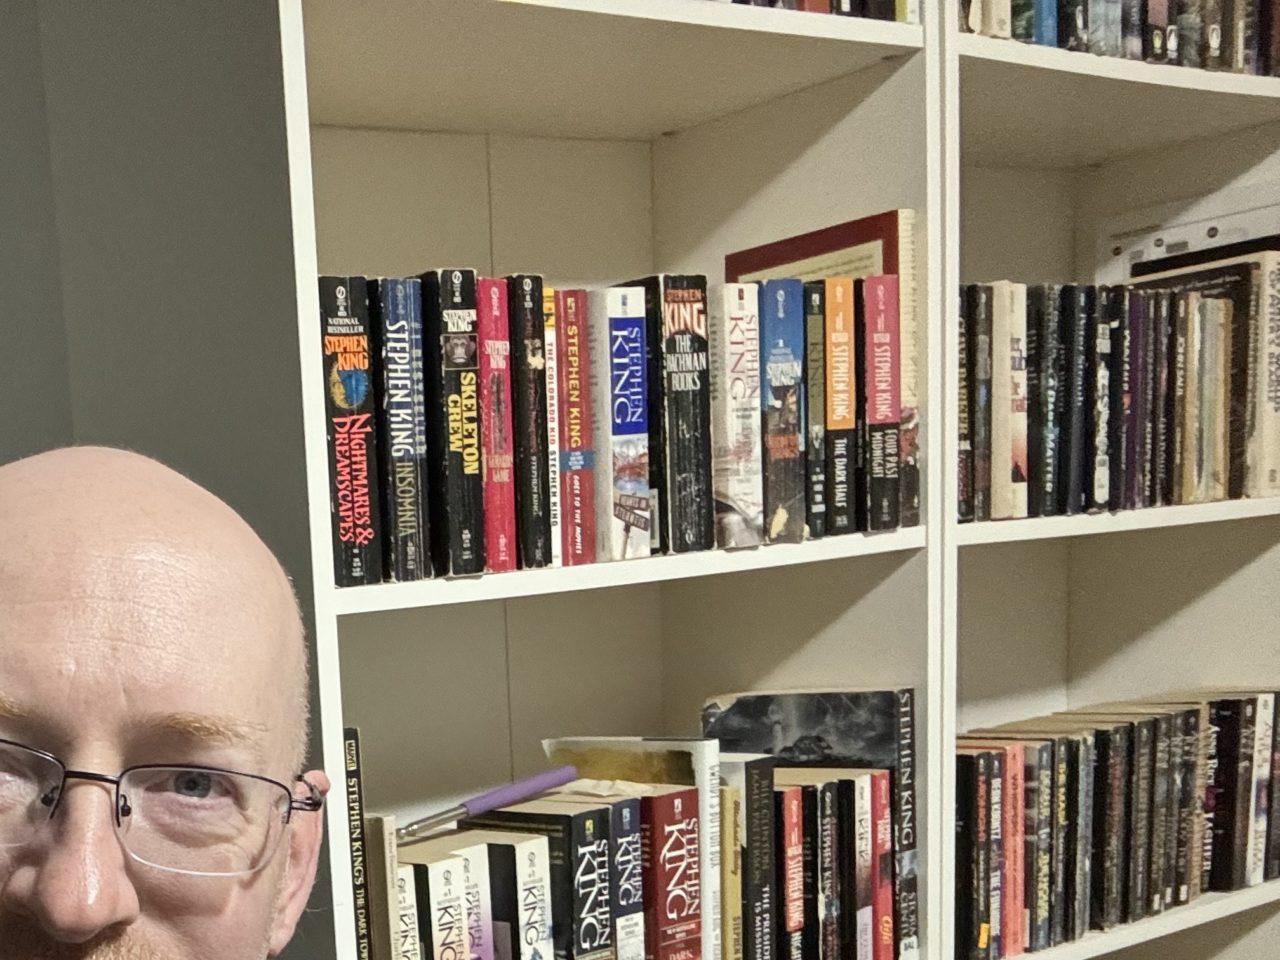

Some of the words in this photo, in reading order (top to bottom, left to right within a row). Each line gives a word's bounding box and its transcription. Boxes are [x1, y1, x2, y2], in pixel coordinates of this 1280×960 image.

[442, 310, 477, 322] STEPHEN
[666, 290, 702, 302] STEPHEN
[1268, 292, 1276, 330] PETER
[447, 319, 473, 332] KING
[664, 302, 707, 340] KING
[325, 335, 368, 355] STEPHEN
[337, 352, 369, 371] KING
[385, 320, 411, 402] STEPHEN
[567, 325, 580, 402] STEPHEN
[665, 353, 706, 371] BACHMAN
[675, 335, 692, 352] THE
[730, 316, 747, 400] KING
[745, 315, 759, 400] STEPHEN
[612, 330, 631, 424] KING
[628, 327, 643, 422] STEPHEN
[671, 372, 701, 391] BOOKS
[832, 346, 850, 388] STEPHEN
[875, 346, 891, 388] STEPHEN
[1267, 352, 1276, 403] BEAGLE
[546, 366, 556, 423] COLORADO
[833, 393, 851, 420] KING
[875, 392, 892, 420] KING
[389, 409, 414, 457] KING
[448, 394, 463, 452] CREW
[461, 372, 479, 475] SKELETON
[548, 427, 556, 445] KID
[569, 408, 582, 449] KING
[884, 429, 898, 456] FOUR
[834, 437, 847, 456] THE
[872, 432, 884, 478] MIDNIGHT
[1045, 434, 1055, 492] MATTER
[332, 415, 355, 542] DREAMSCAPES
[349, 412, 373, 525] NIGHTMARES
[549, 451, 557, 498] STEPHEN
[573, 475, 581, 494] GOES
[835, 458, 847, 482] DARK
[885, 457, 898, 478] PAST
[395, 462, 417, 537] INSOMNIA
[550, 502, 558, 527] KING
[573, 497, 581, 506] TO
[574, 510, 582, 522] THE
[835, 485, 847, 508] HALF
[355, 528, 375, 547] &
[575, 526, 583, 554] MOVIES
[345, 740, 357, 770] MARVEL
[899, 693, 912, 787] STEPHEN
[1205, 723, 1220, 756] ANNE
[1206, 759, 1220, 786] RICE
[347, 777, 363, 839] STEPHEN
[901, 792, 914, 845] KING
[760, 808, 770, 870] CLINTON
[821, 817, 833, 869] STEPHEN
[1203, 811, 1216, 871] LASHER
[351, 841, 366, 885] KING'S
[615, 834, 635, 905] KING
[631, 833, 643, 903] STEPHEN
[660, 821, 688, 920] KING
[685, 818, 700, 914] STEPHEN
[787, 856, 802, 898] STEPHEN
[355, 889, 366, 908] THE
[574, 841, 600, 952] KING
[594, 838, 611, 945] STEPHEN
[762, 885, 771, 911] THE
[823, 871, 834, 902] KING
[357, 909, 368, 936] DARK
[472, 891, 483, 948] STEPHEN
[523, 885, 540, 946] KING
[536, 885, 546, 942] STEPHEN
[754, 902, 763, 913] IS
[788, 901, 803, 928] KING
[733, 916, 742, 955] STEPHEN
[790, 931, 802, 960] NIGHT
